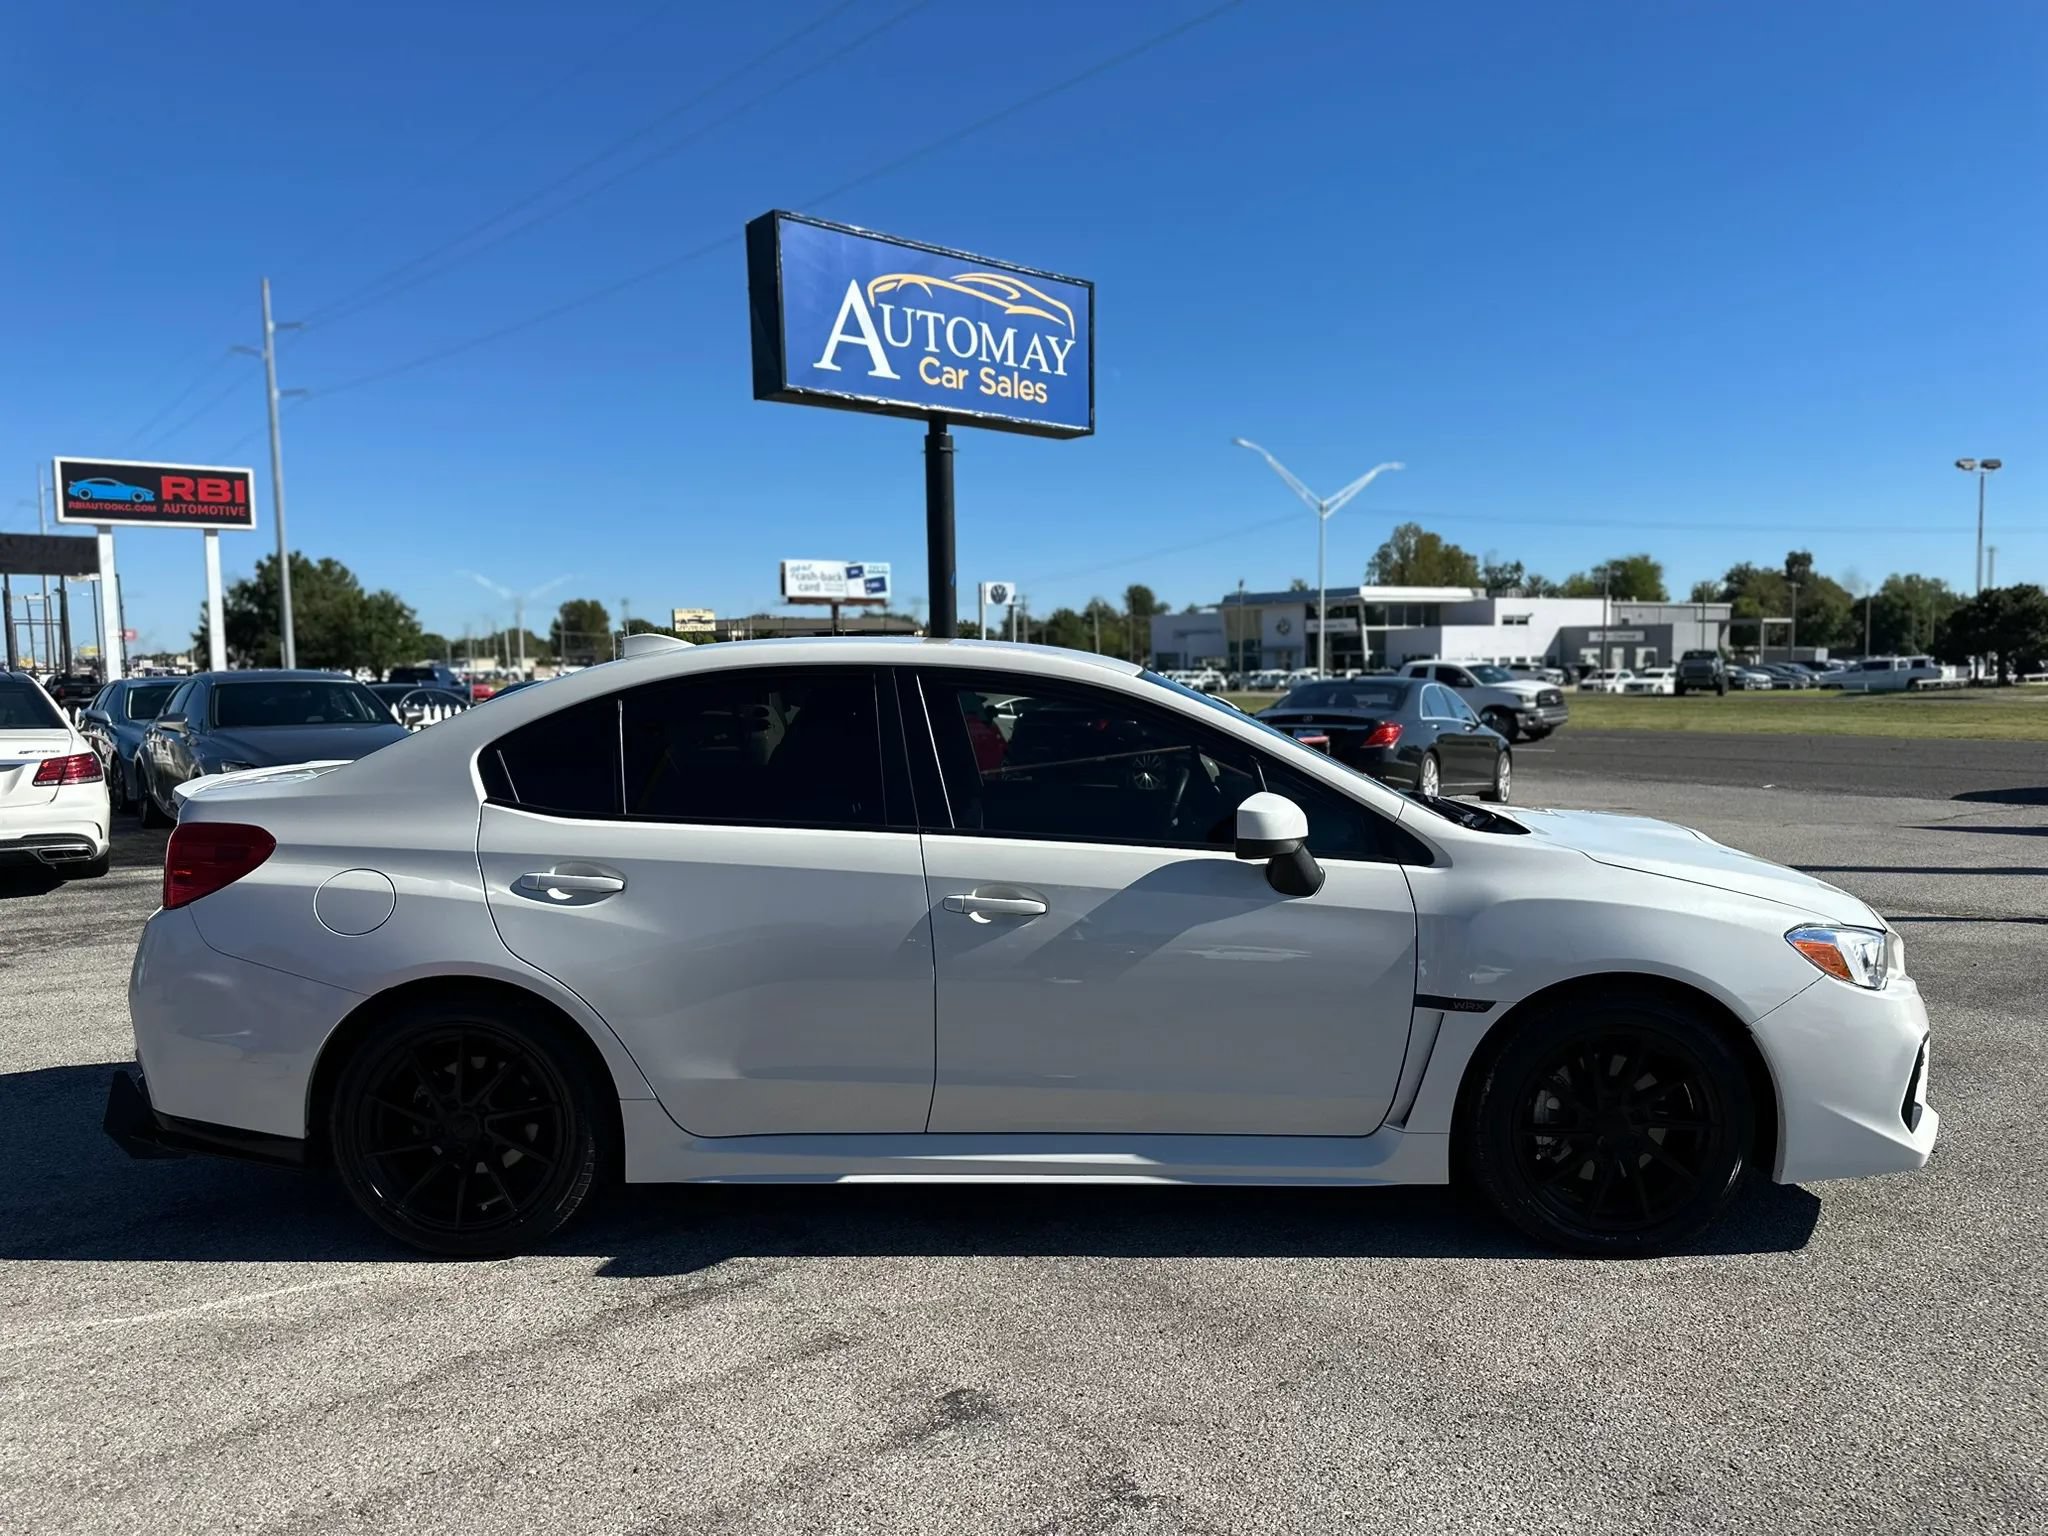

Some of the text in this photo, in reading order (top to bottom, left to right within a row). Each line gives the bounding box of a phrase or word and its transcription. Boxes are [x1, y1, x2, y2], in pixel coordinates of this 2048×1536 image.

[812, 279, 1076, 380] AUTOMAY
[918, 357, 1048, 404] Car Sales
[160, 475, 246, 504] RBI
[67, 500, 158, 513] RBIAUTOOKC.COM
[162, 503, 246, 517] AUTOMOTIVE
[1452, 1000, 1486, 1011] WRX
